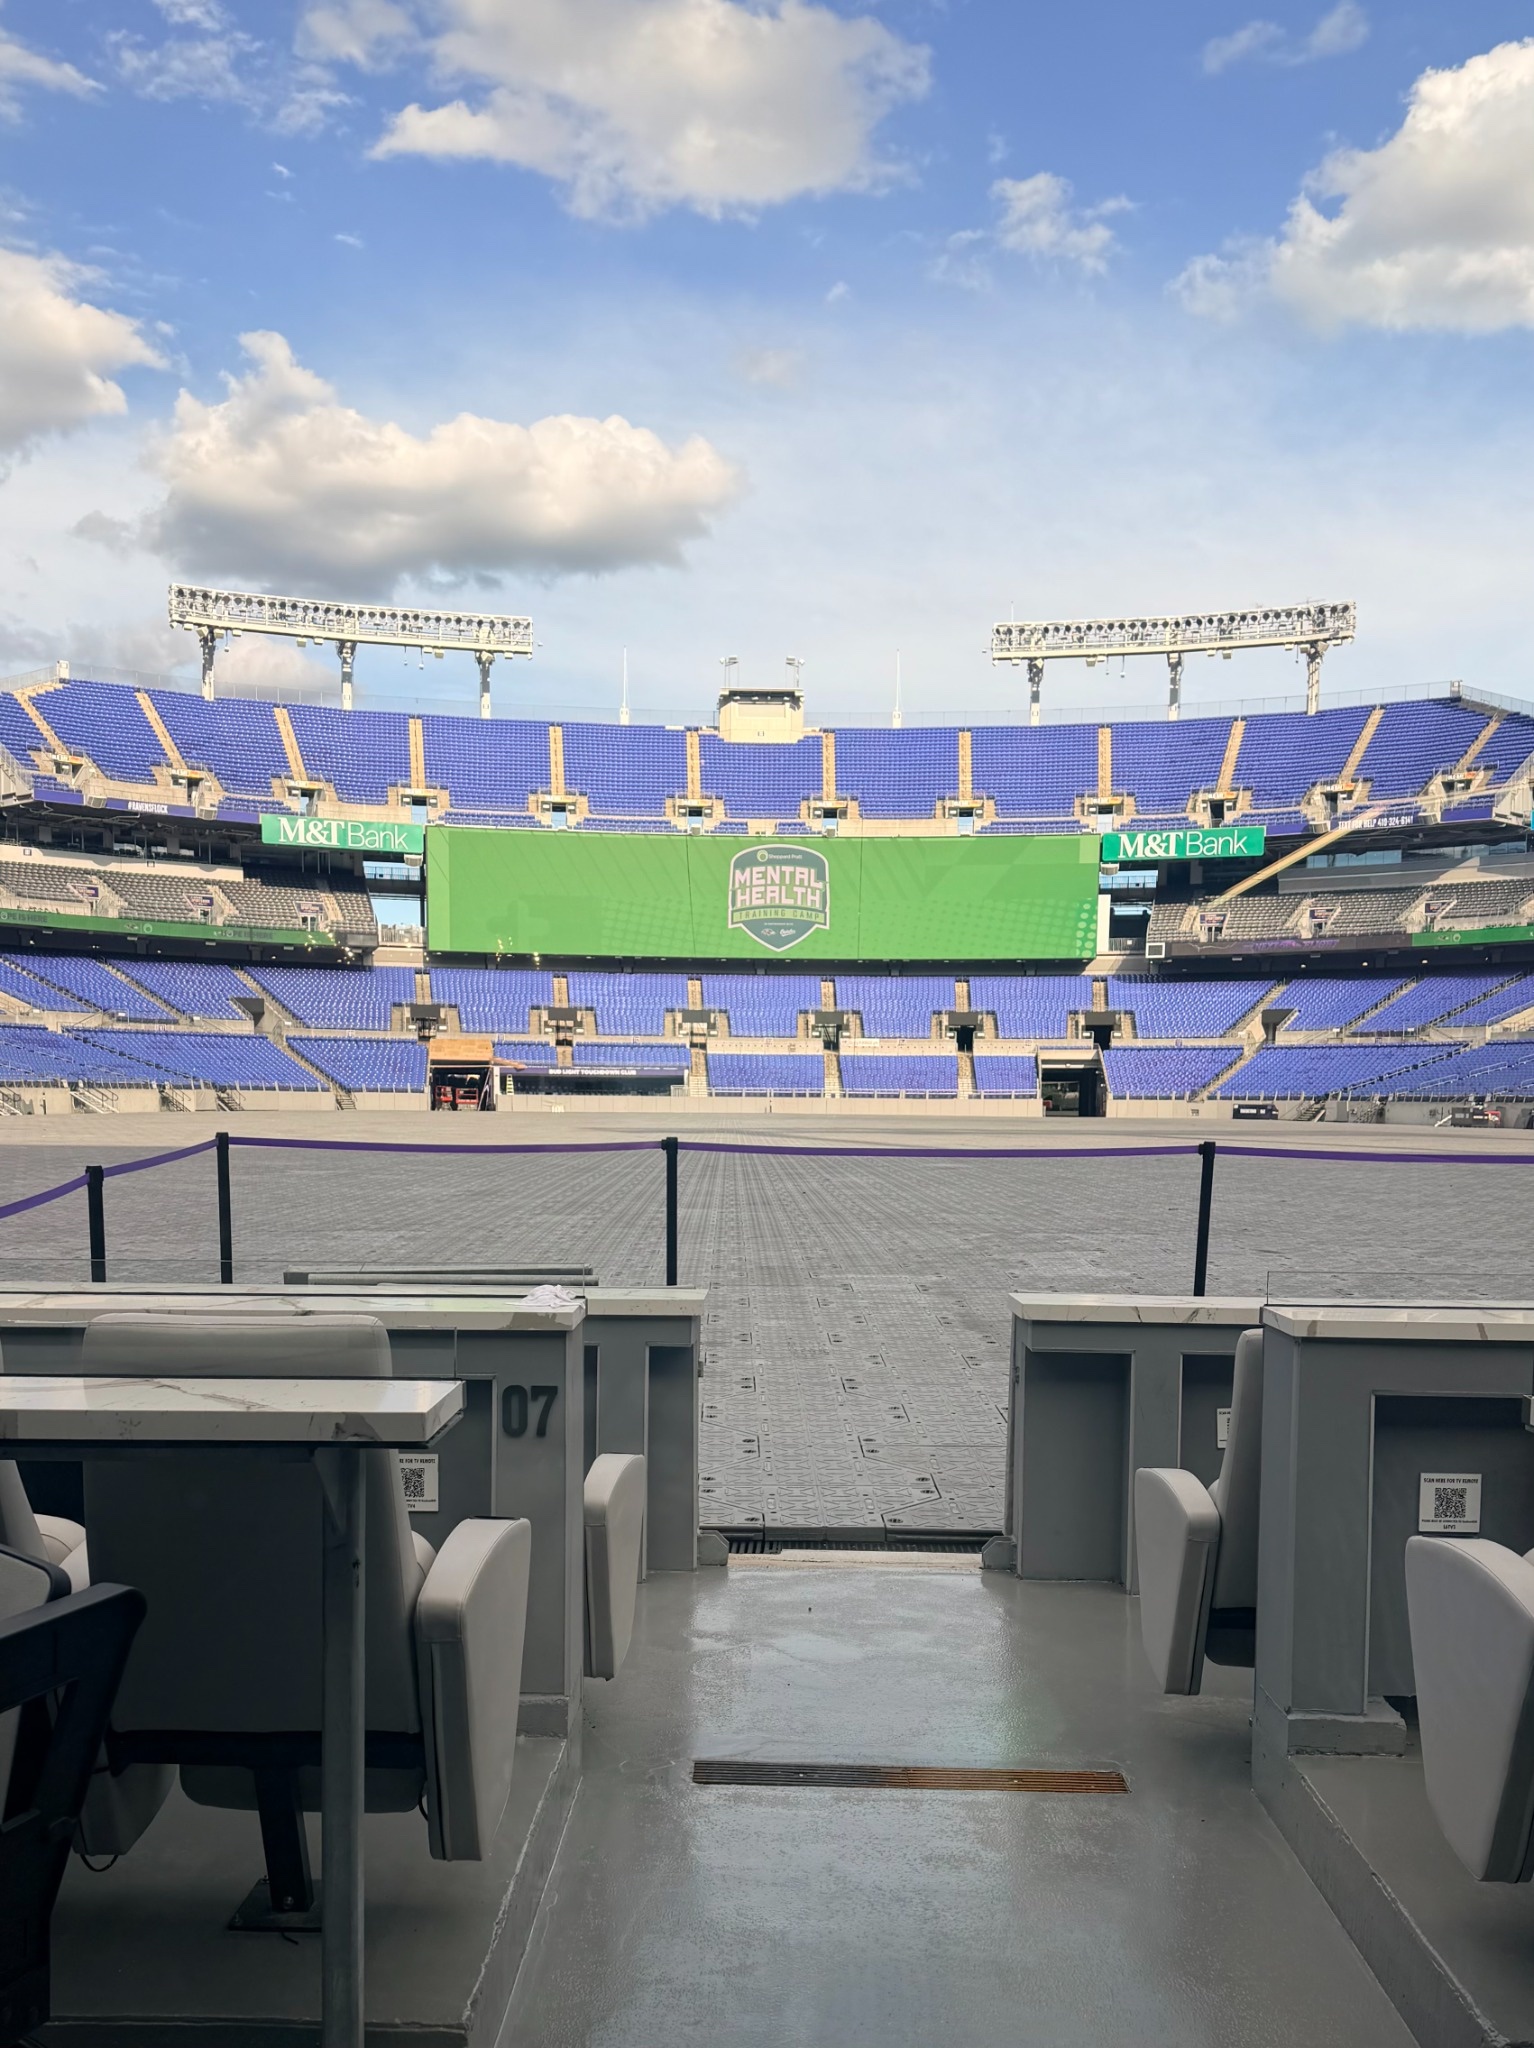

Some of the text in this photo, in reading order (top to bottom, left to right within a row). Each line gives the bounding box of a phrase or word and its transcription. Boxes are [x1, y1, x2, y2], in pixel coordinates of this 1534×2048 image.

[277, 817, 409, 850] M&T Bank
[1117, 830, 1248, 859] M&T Bank
[734, 865, 823, 889] MENTAL
[736, 886, 820, 908] HEALTH
[739, 909, 820, 920] TRAINING CAMP
[501, 1384, 559, 1438] 07
